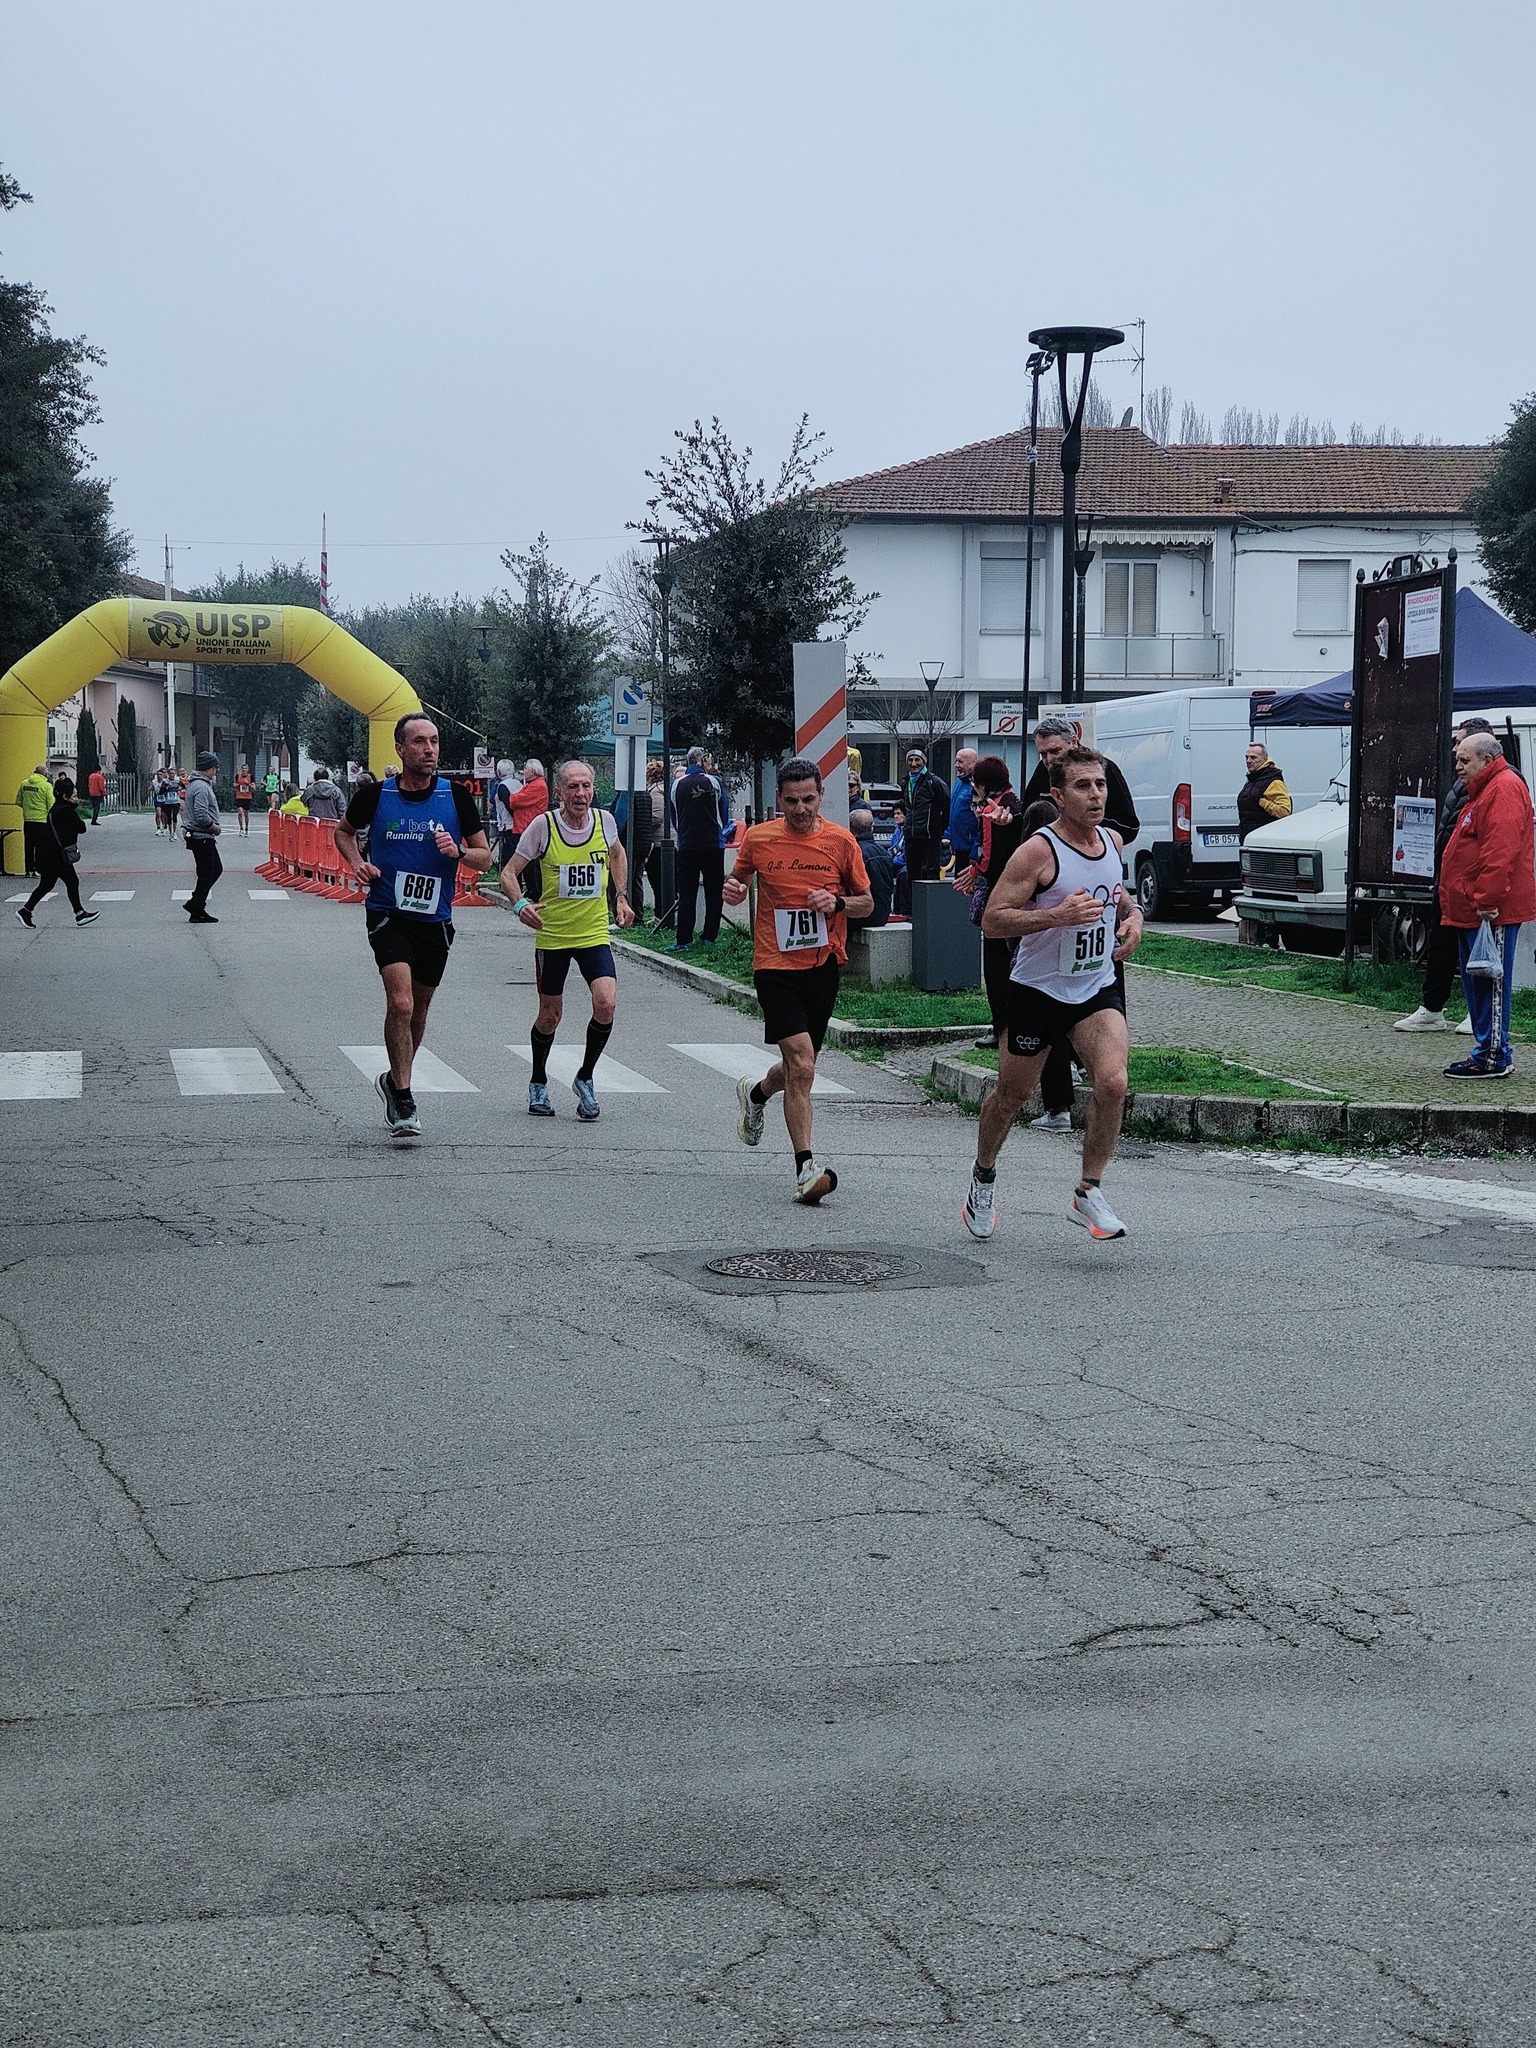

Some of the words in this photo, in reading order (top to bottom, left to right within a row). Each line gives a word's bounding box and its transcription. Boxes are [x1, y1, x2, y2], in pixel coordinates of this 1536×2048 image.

[195, 612, 271, 638] UISP
[195, 638, 230, 647] UNIONE
[232, 639, 272, 648] ITALIANA
[195, 647, 223, 655] SPORT
[244, 648, 267, 656] TUTTI
[386, 831, 424, 842] Running
[1209, 835, 1220, 844] GB
[1221, 834, 1240, 844] 057
[788, 858, 832, 872] Lamone
[568, 865, 595, 887] 656
[403, 874, 436, 901] 688
[787, 909, 818, 937] 761
[1075, 926, 1106, 960] 518
